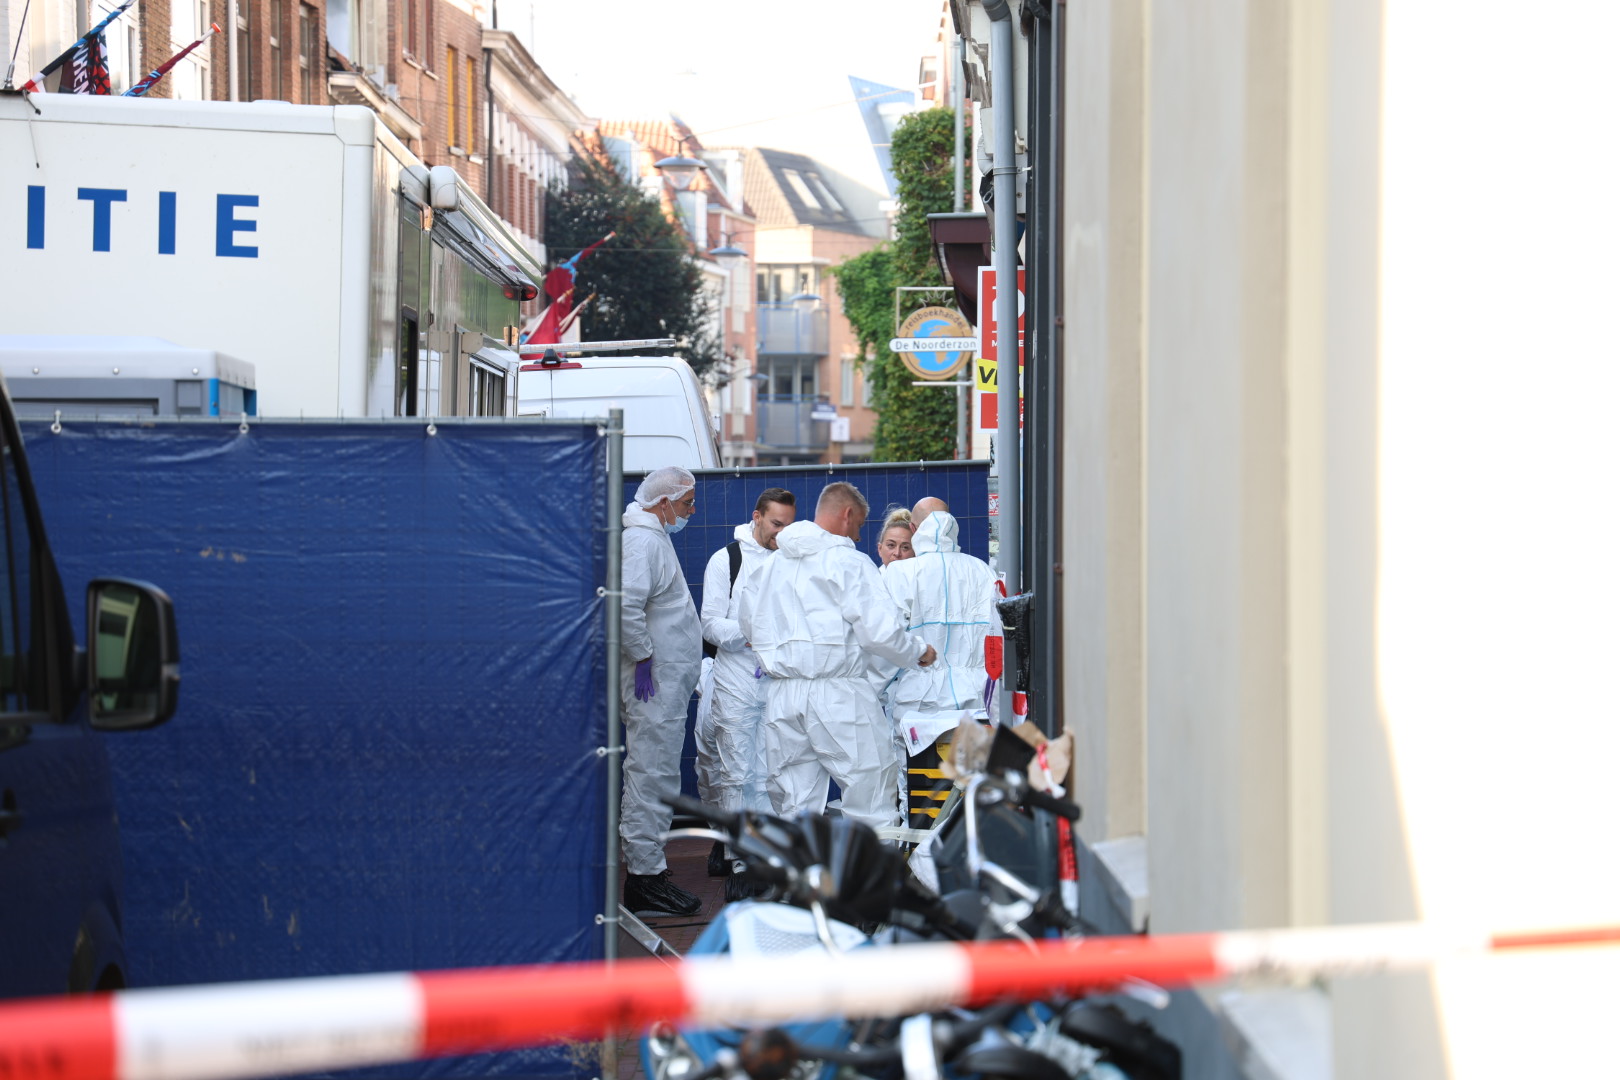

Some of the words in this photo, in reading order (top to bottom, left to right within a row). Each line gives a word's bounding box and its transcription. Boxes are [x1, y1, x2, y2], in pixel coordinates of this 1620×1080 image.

[27, 185, 259, 258] ITIE
[905, 309, 965, 330] reisboekhandel
[895, 341, 909, 350] De
[913, 339, 977, 350] Noorderzon
